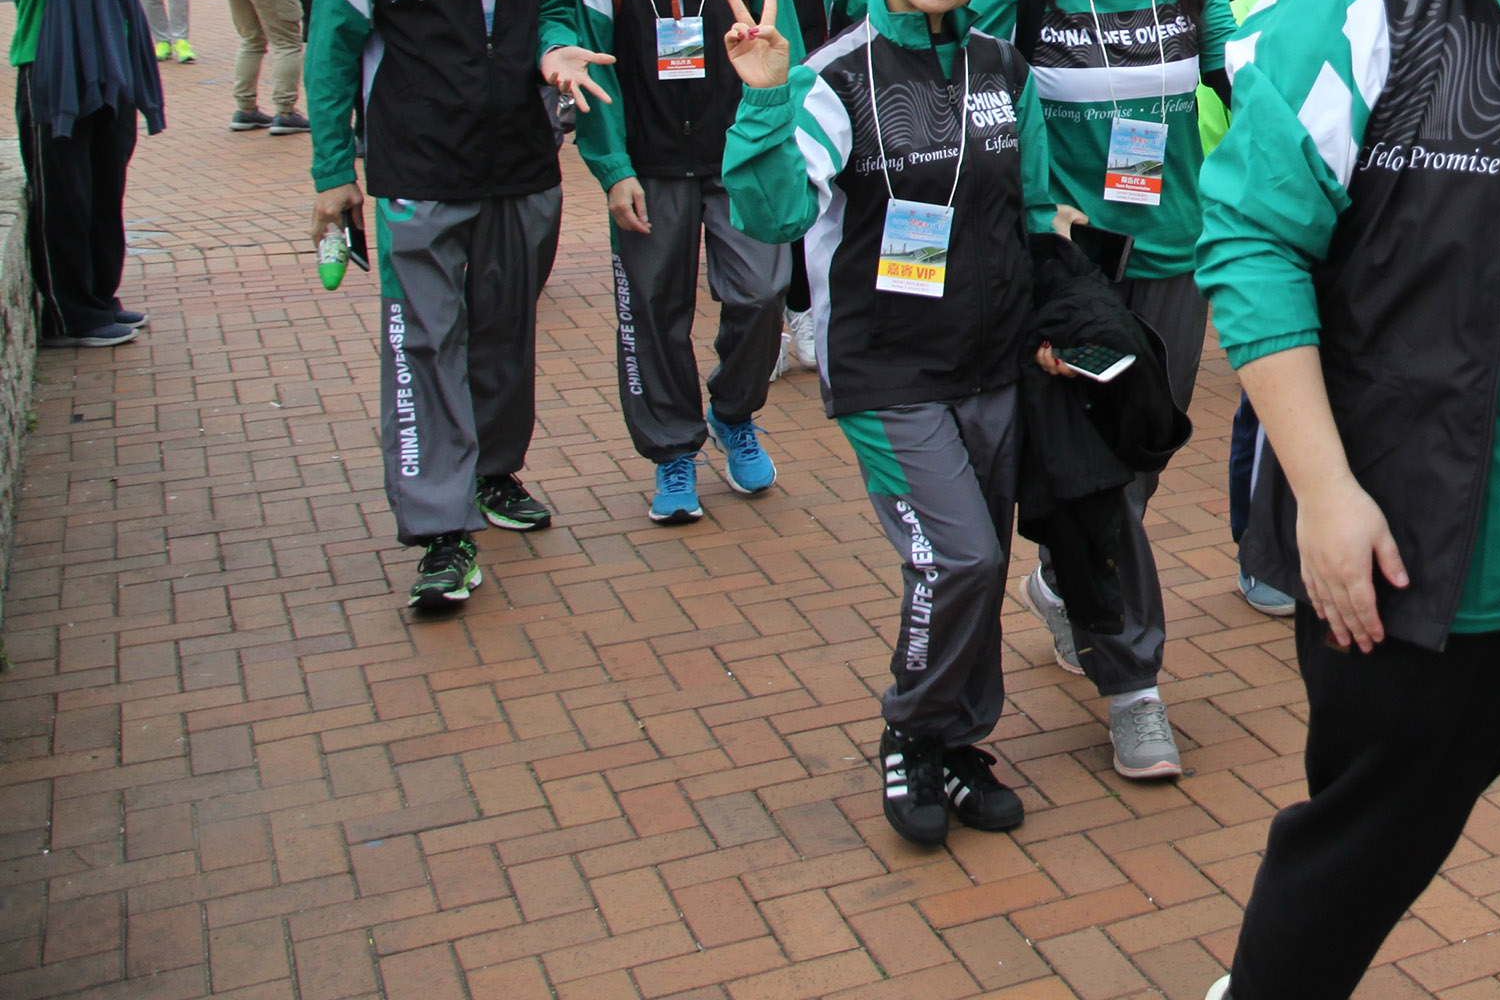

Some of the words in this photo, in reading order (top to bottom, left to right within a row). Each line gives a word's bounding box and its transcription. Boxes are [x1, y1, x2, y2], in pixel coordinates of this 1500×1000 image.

[964, 91, 1012, 111] CHINA
[1044, 104, 1080, 123] ifelong
[1084, 107, 1133, 121] Promise
[1151, 99, 1194, 117] Lifelong
[856, 155, 904, 176] Lifelong
[909, 145, 958, 165] Promise
[612, 254, 633, 321] OVERSEAS
[888, 262, 913, 277] 嘉賓
[916, 267, 936, 280] VIP
[621, 324, 635, 353] LIFE
[626, 356, 644, 395] CHINA
[397, 388, 416, 423] LIFE
[400, 426, 420, 477] CHINA
[911, 583, 934, 624] LIFE
[906, 626, 930, 671] CHINA
